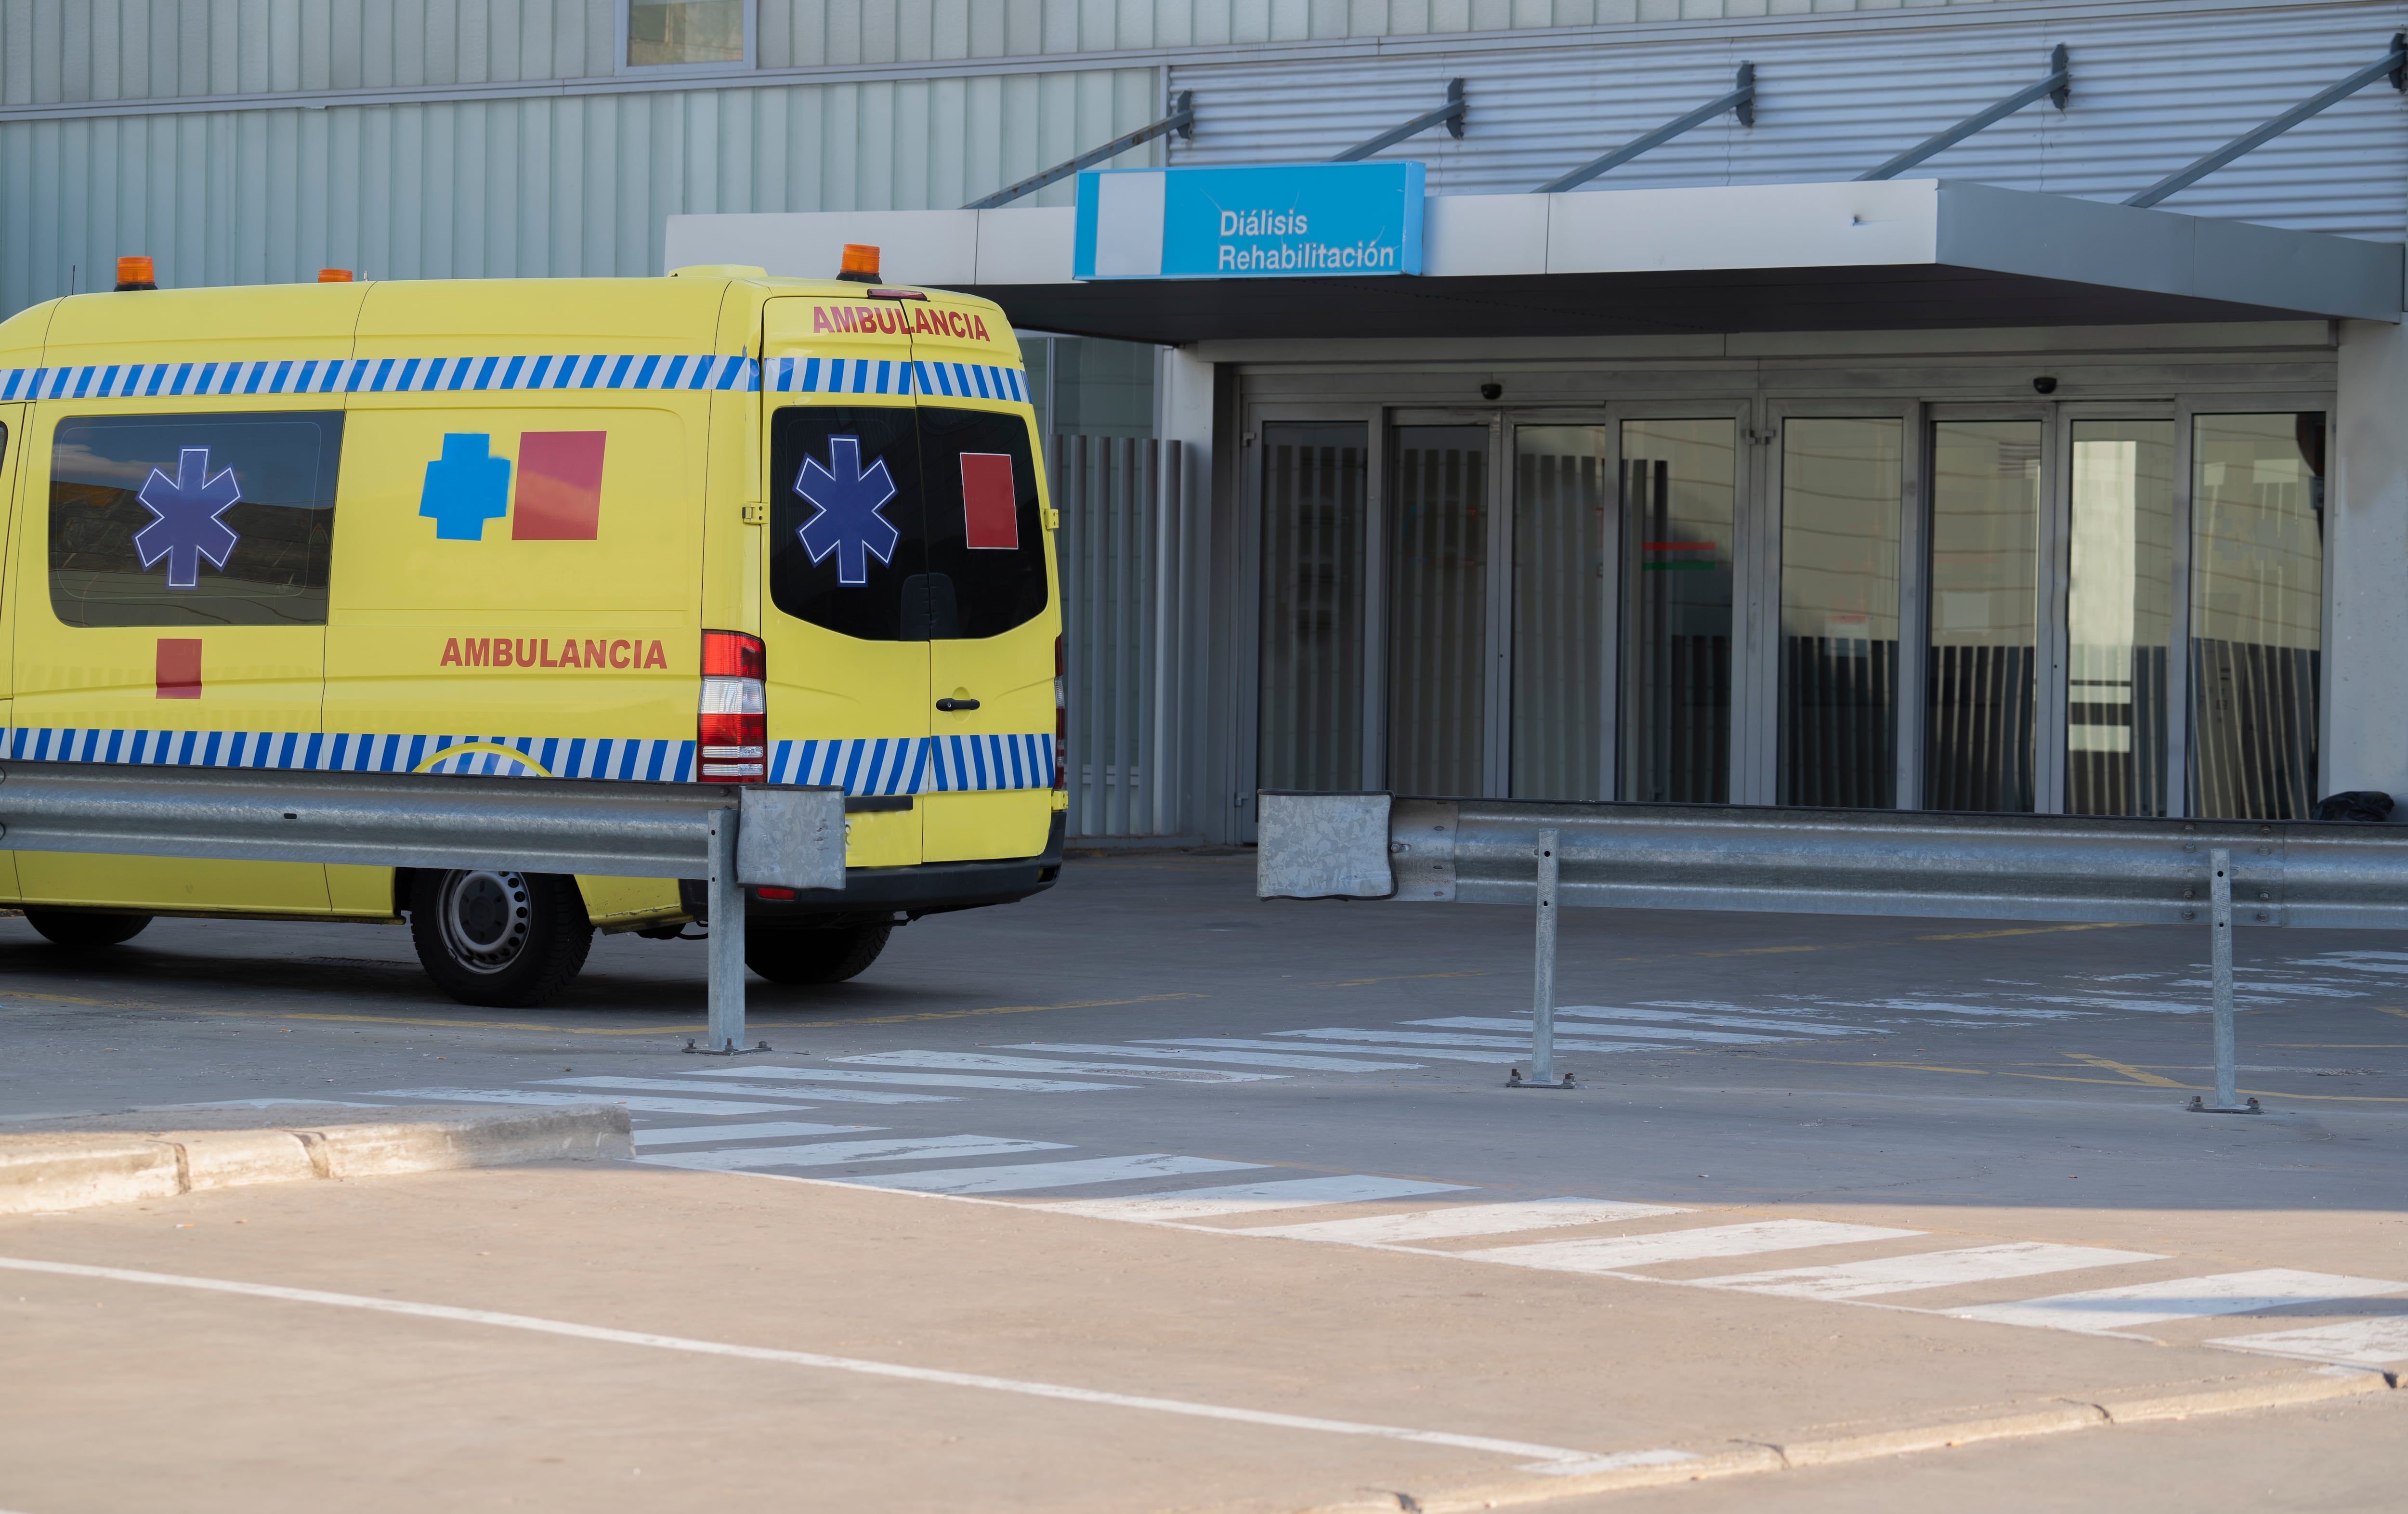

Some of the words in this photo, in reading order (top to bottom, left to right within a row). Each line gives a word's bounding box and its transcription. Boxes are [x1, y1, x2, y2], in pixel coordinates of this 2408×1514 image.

[1220, 209, 1308, 237] Diálisis
[1218, 241, 1394, 271] Rehabilitación
[813, 306, 991, 342] AMBULANCIA
[440, 638, 667, 669] AMBULANCIA
